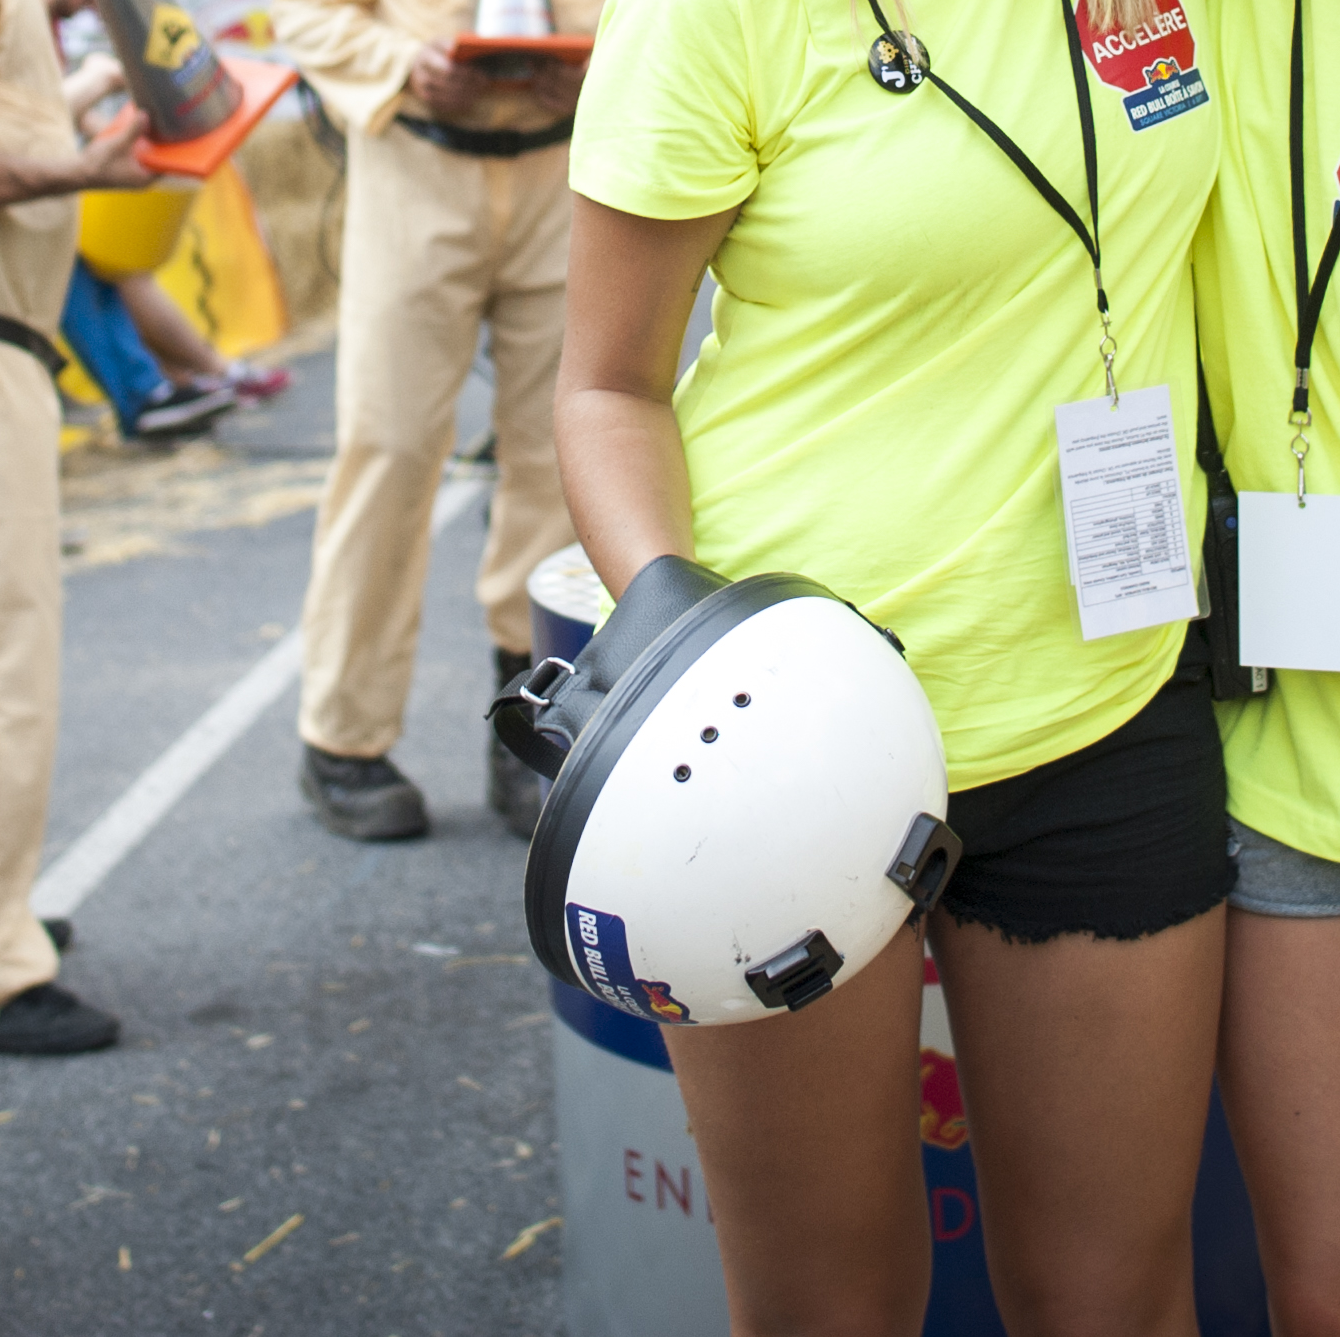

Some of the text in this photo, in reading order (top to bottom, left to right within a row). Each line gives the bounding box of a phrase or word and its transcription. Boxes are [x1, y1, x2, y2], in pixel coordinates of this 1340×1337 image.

[1130, 104, 1148, 120] RED
[1147, 97, 1166, 113] BULL
[578, 909, 610, 982] RED BULL
